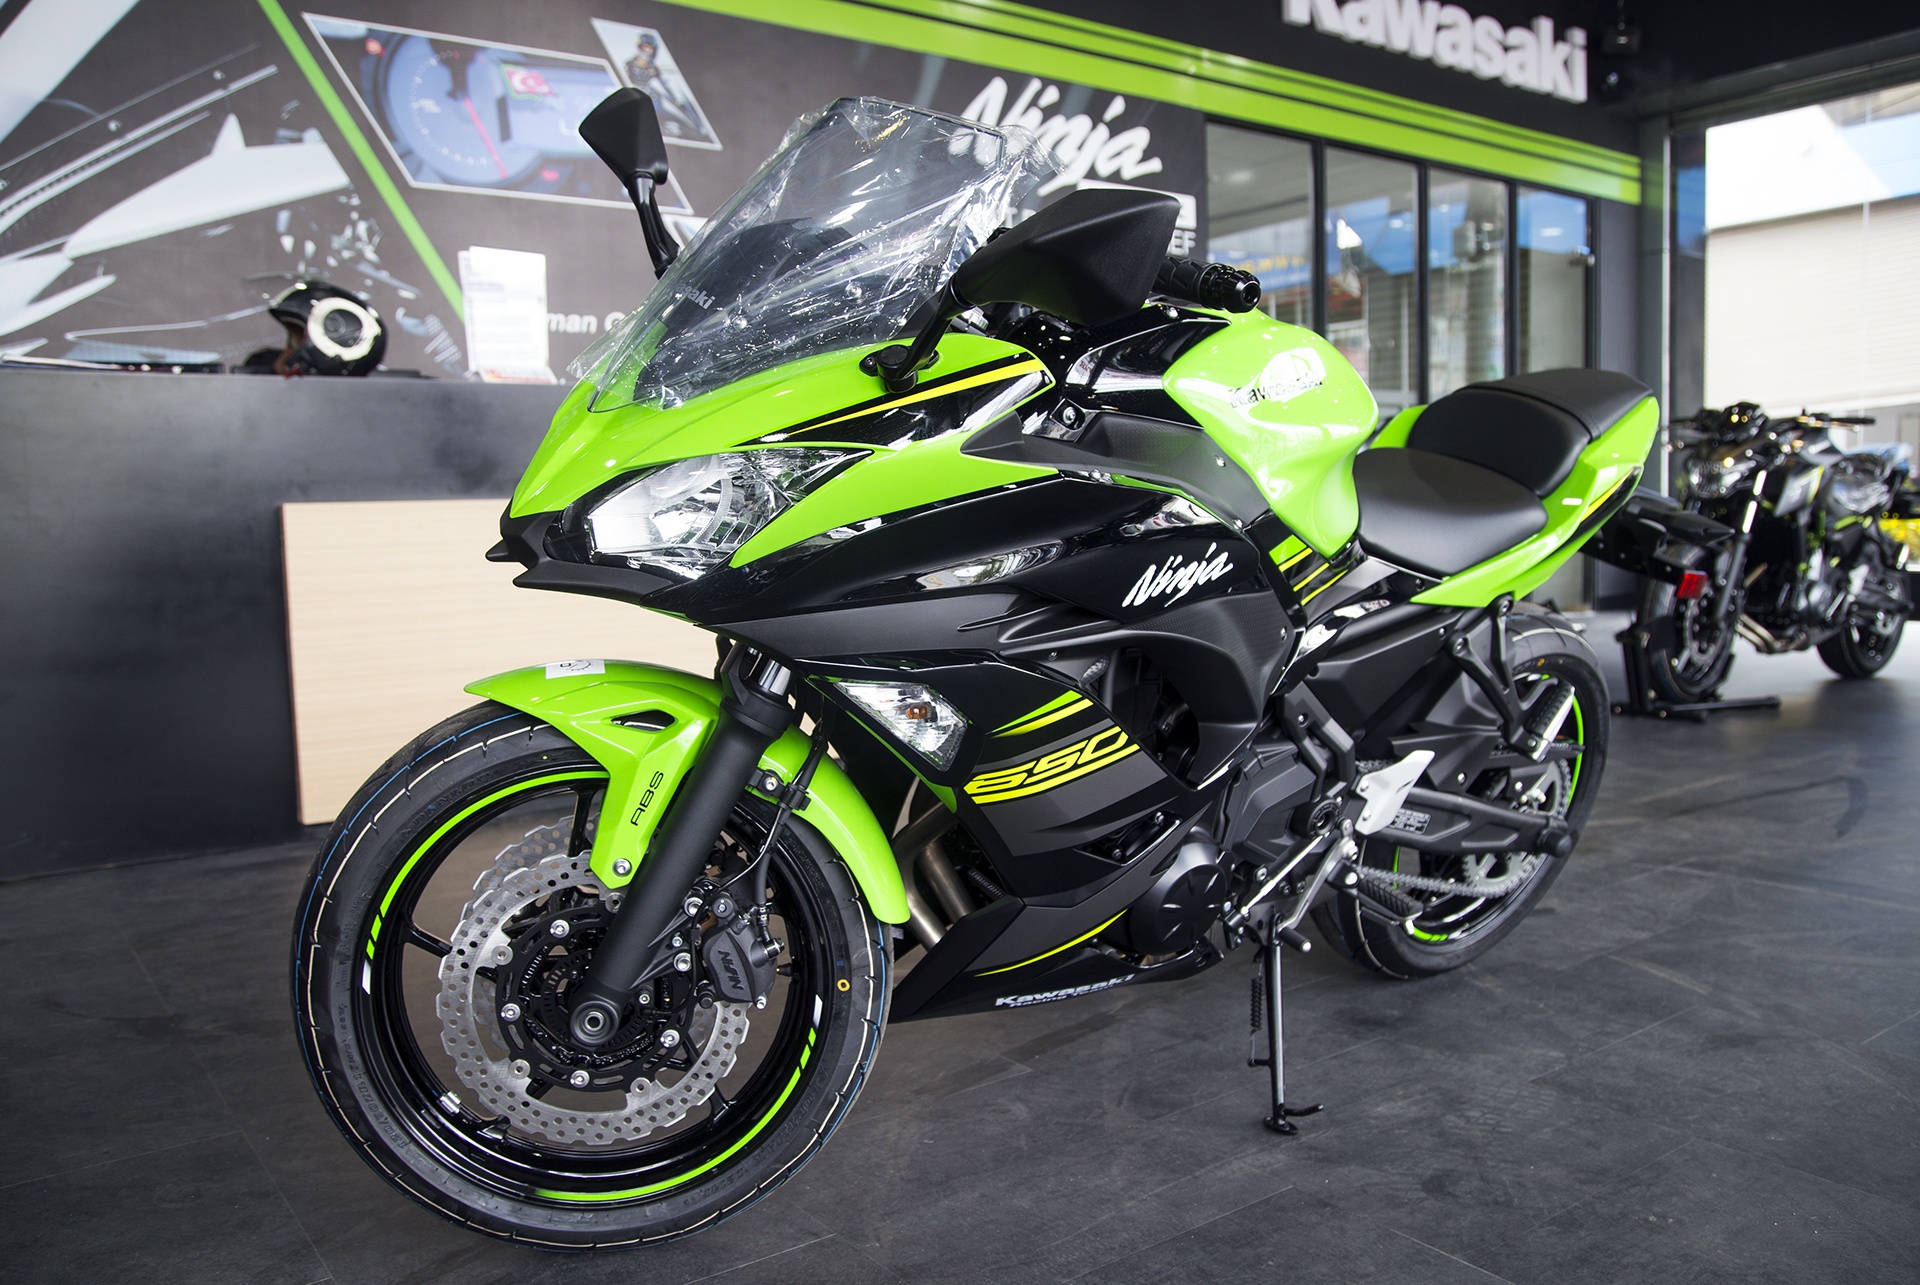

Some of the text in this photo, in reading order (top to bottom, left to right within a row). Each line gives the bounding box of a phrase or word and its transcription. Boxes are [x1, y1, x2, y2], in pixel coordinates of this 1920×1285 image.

[948, 76, 1163, 197] Ninja
[547, 312, 598, 334] man
[1121, 541, 1234, 608] Ninja
[963, 725, 1129, 796] 650
[630, 770, 665, 827] ABS
[994, 973, 1136, 1007] Kawasaki
